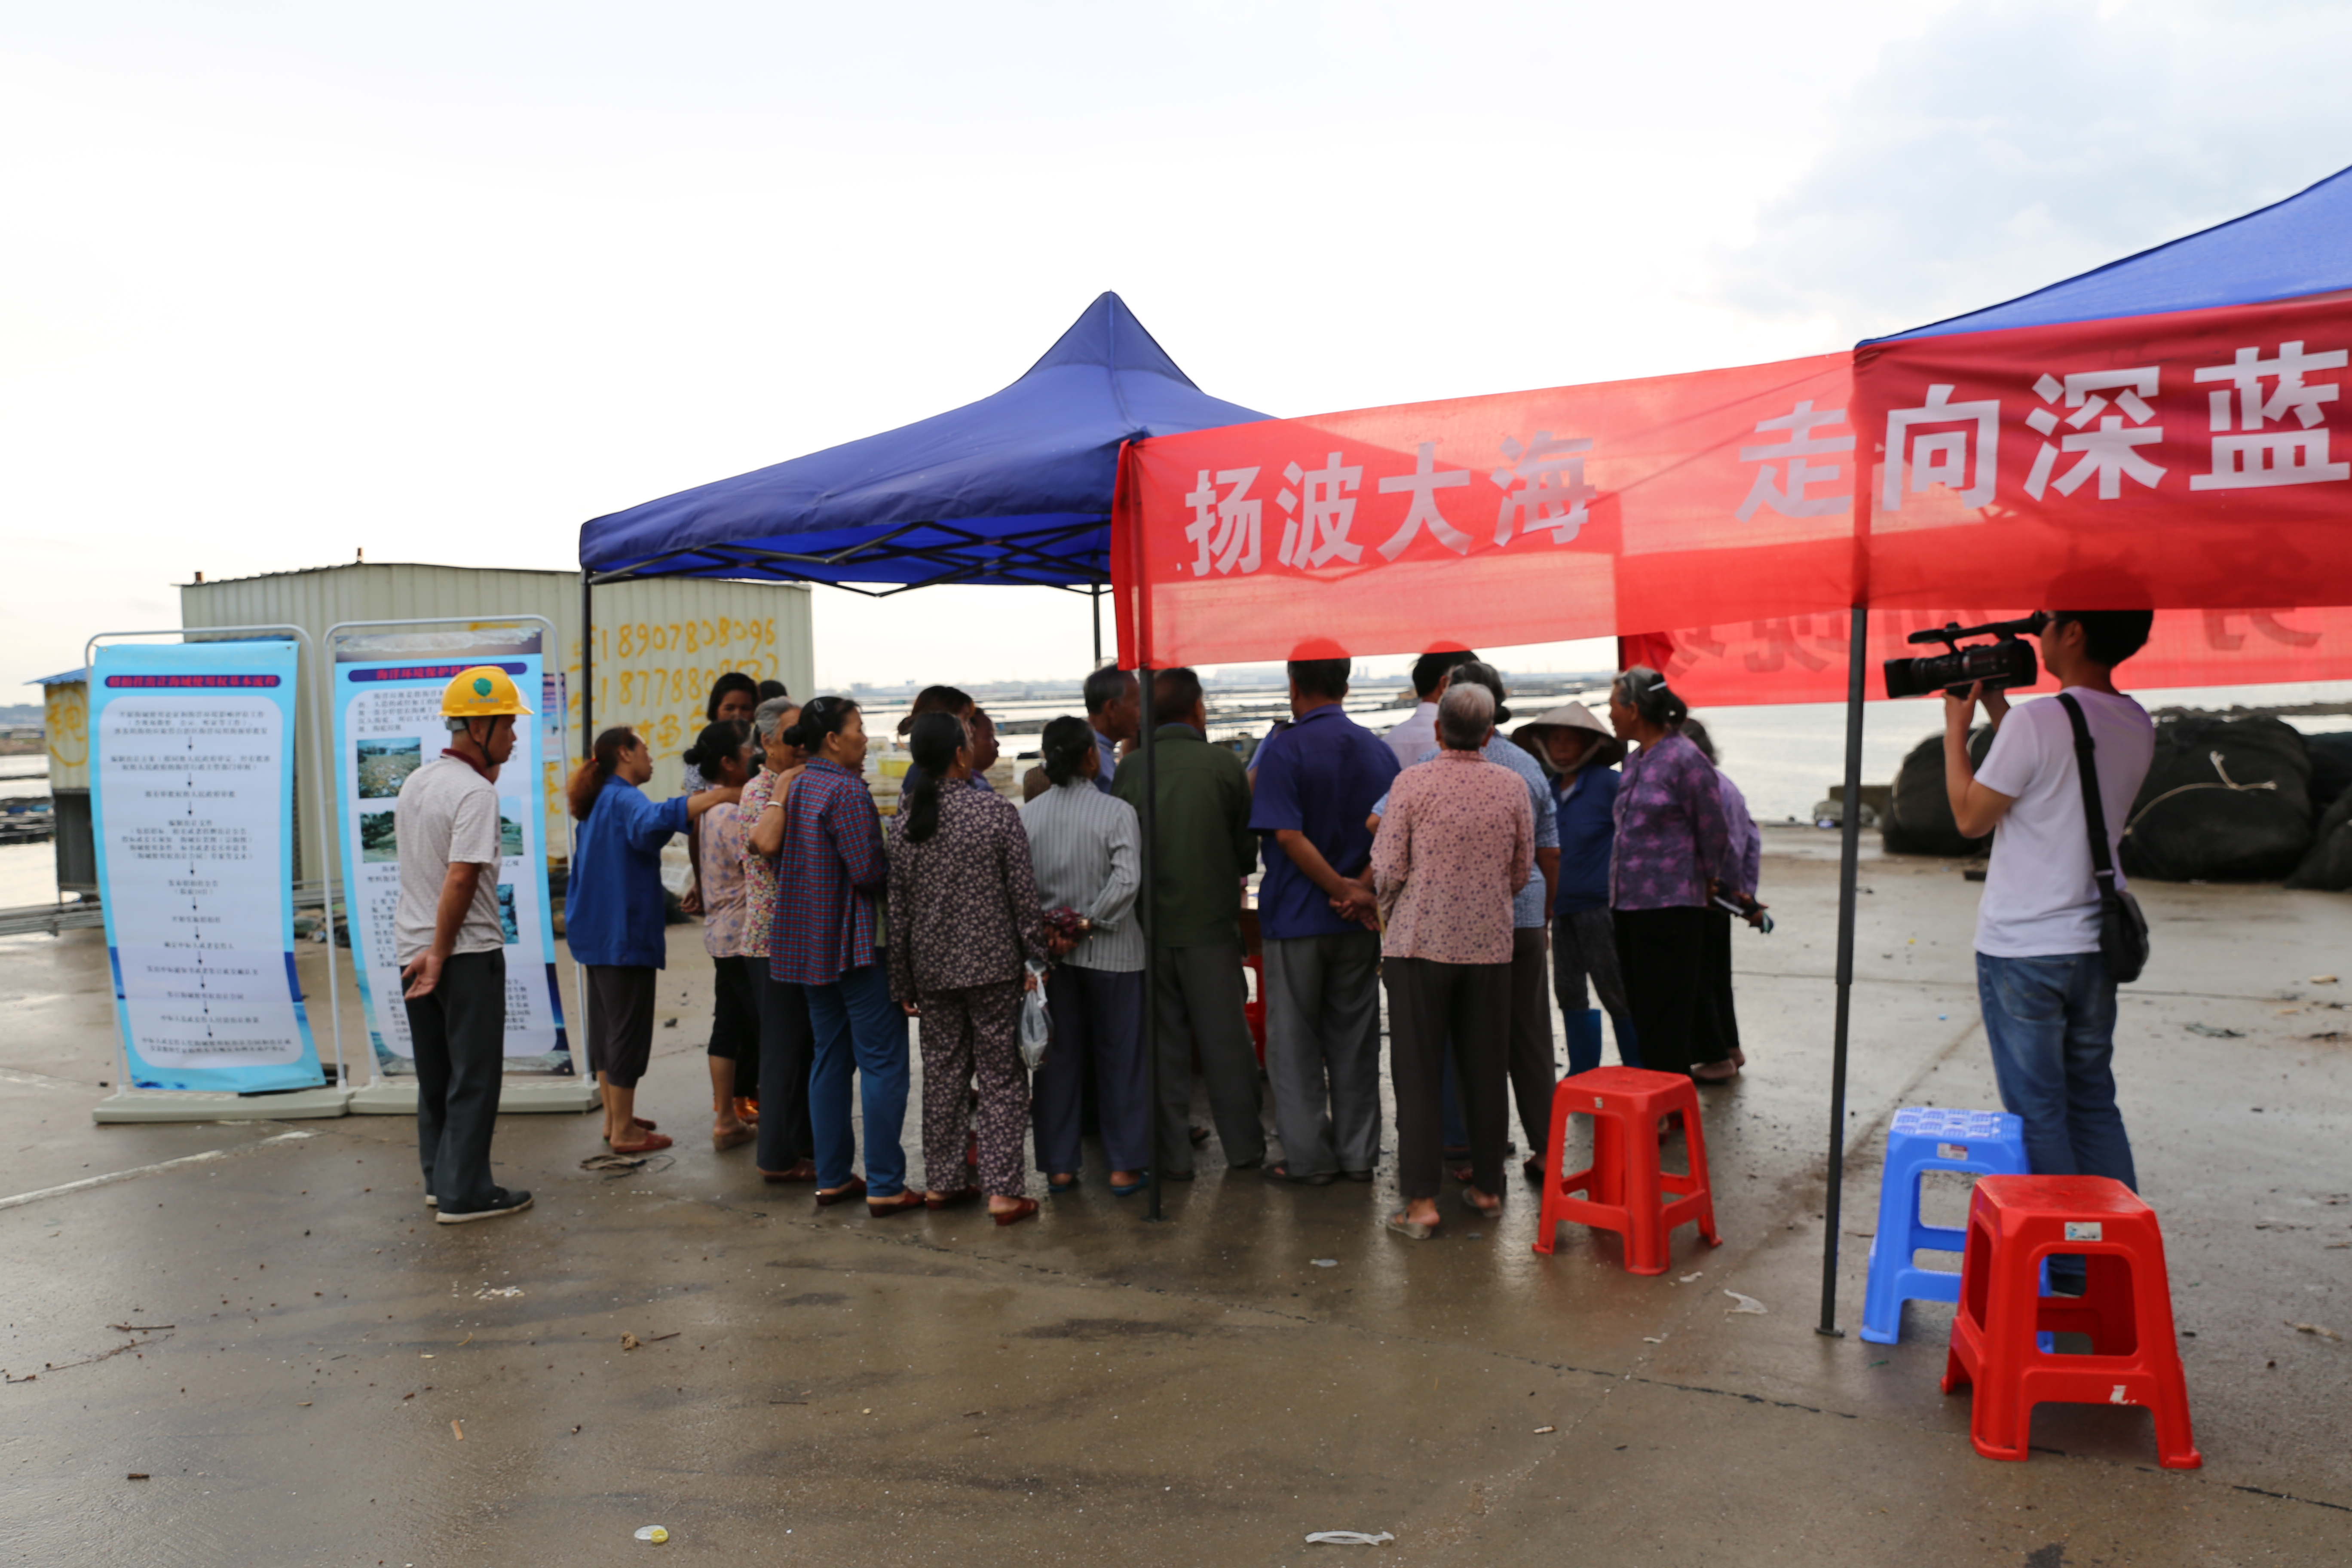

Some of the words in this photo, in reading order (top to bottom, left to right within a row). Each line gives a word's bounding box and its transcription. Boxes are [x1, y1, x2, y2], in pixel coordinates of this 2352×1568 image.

[1185, 430, 1597, 577] 扬波大海
[1735, 340, 2351, 524] 走向深蓝
